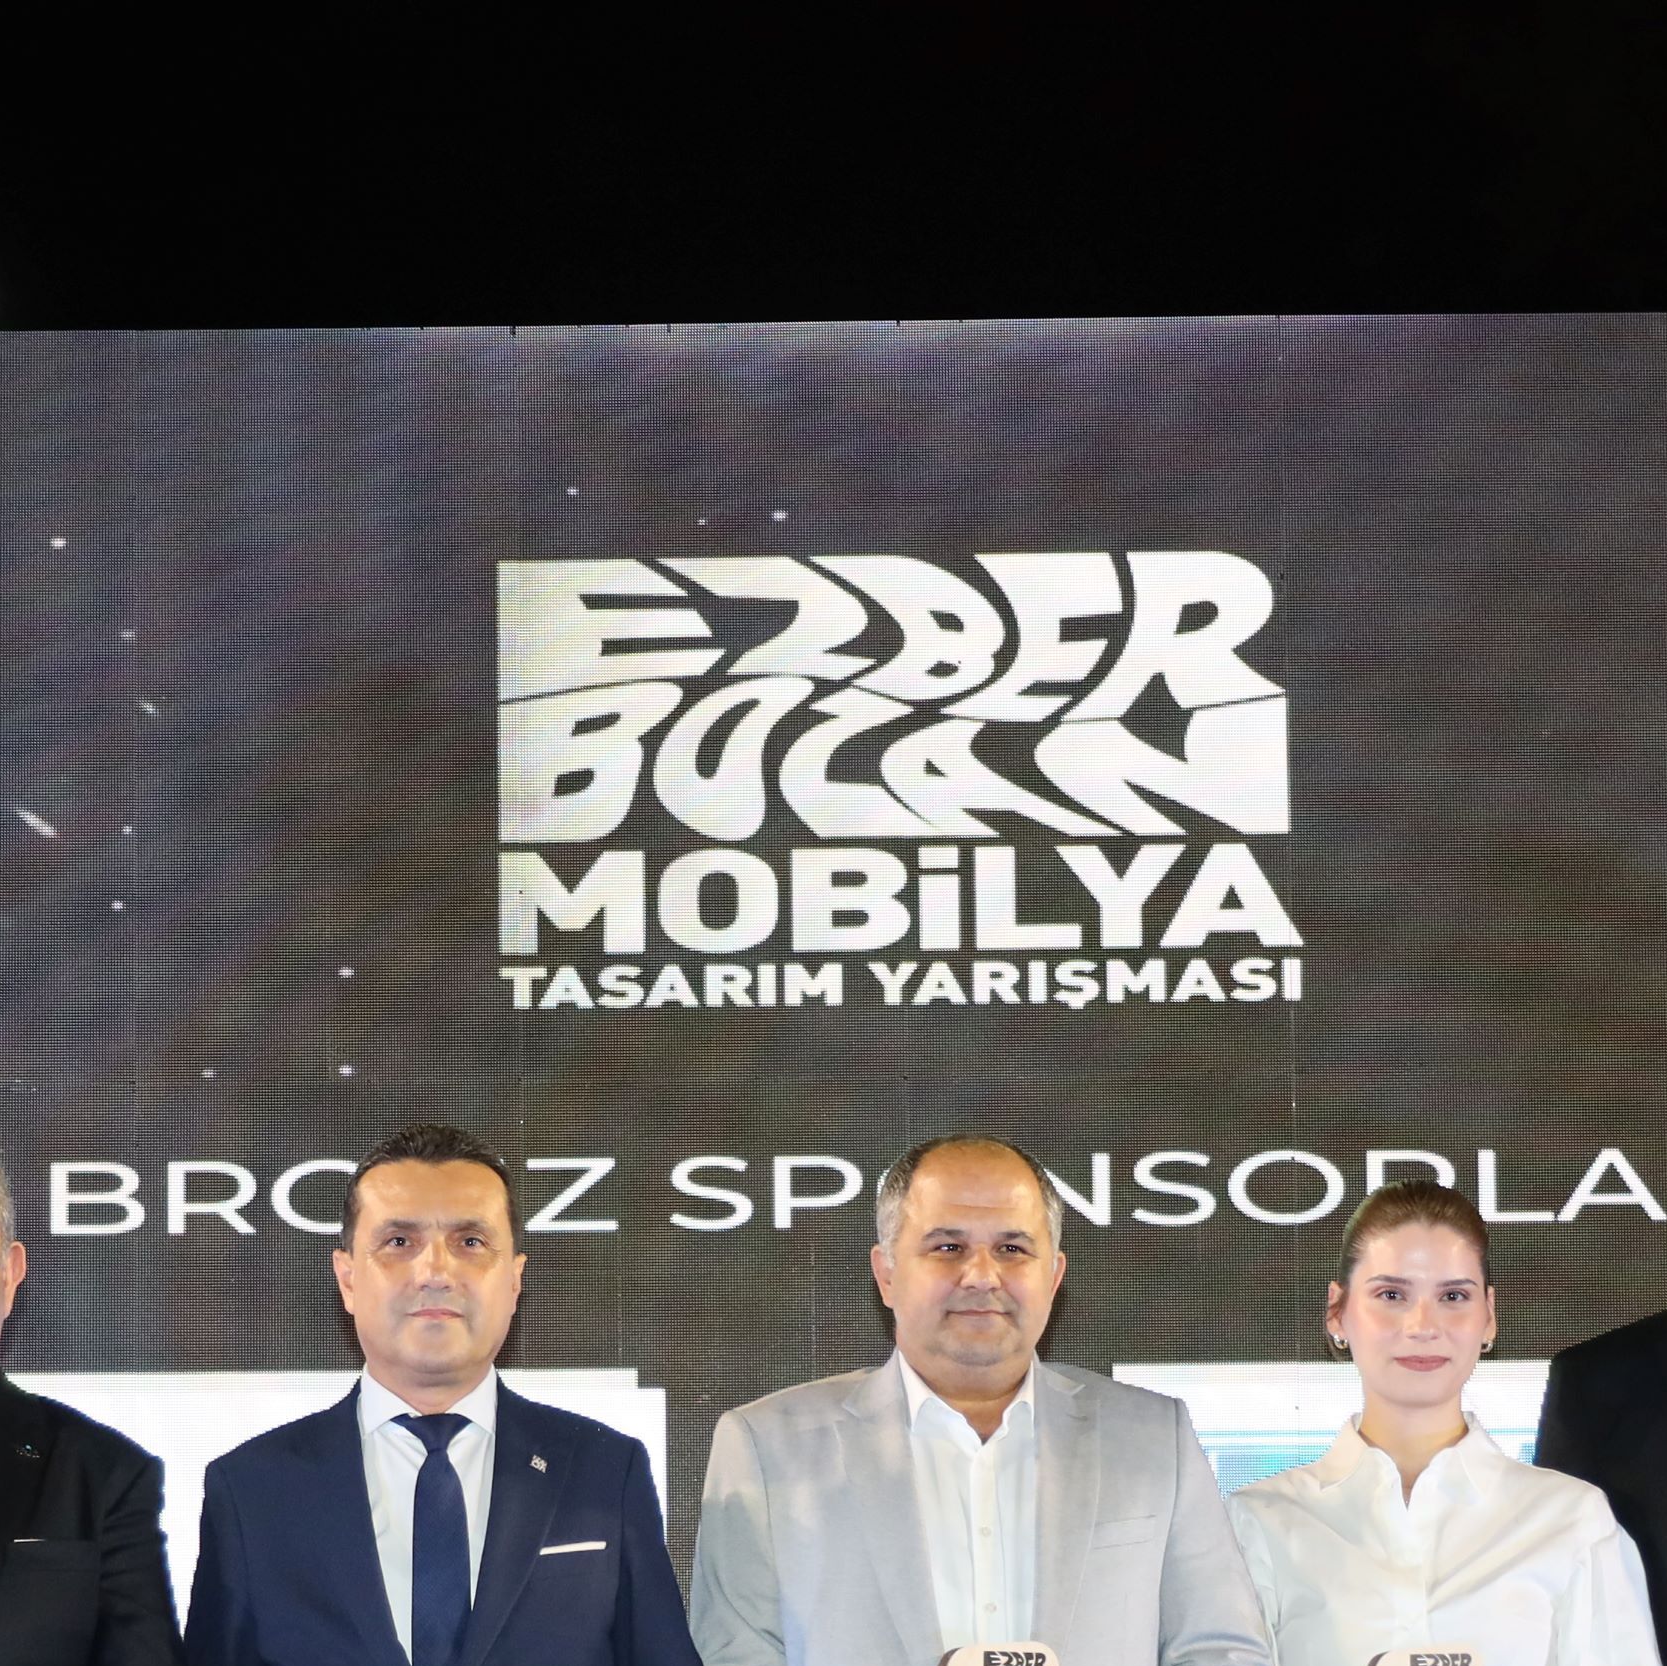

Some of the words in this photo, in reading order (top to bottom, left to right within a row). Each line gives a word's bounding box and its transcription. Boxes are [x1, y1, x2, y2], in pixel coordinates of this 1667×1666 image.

[500, 962, 844, 1010] TASARIM
[869, 957, 1303, 1010] YARIŞMASI
[49, 1157, 619, 1236] BROZ
